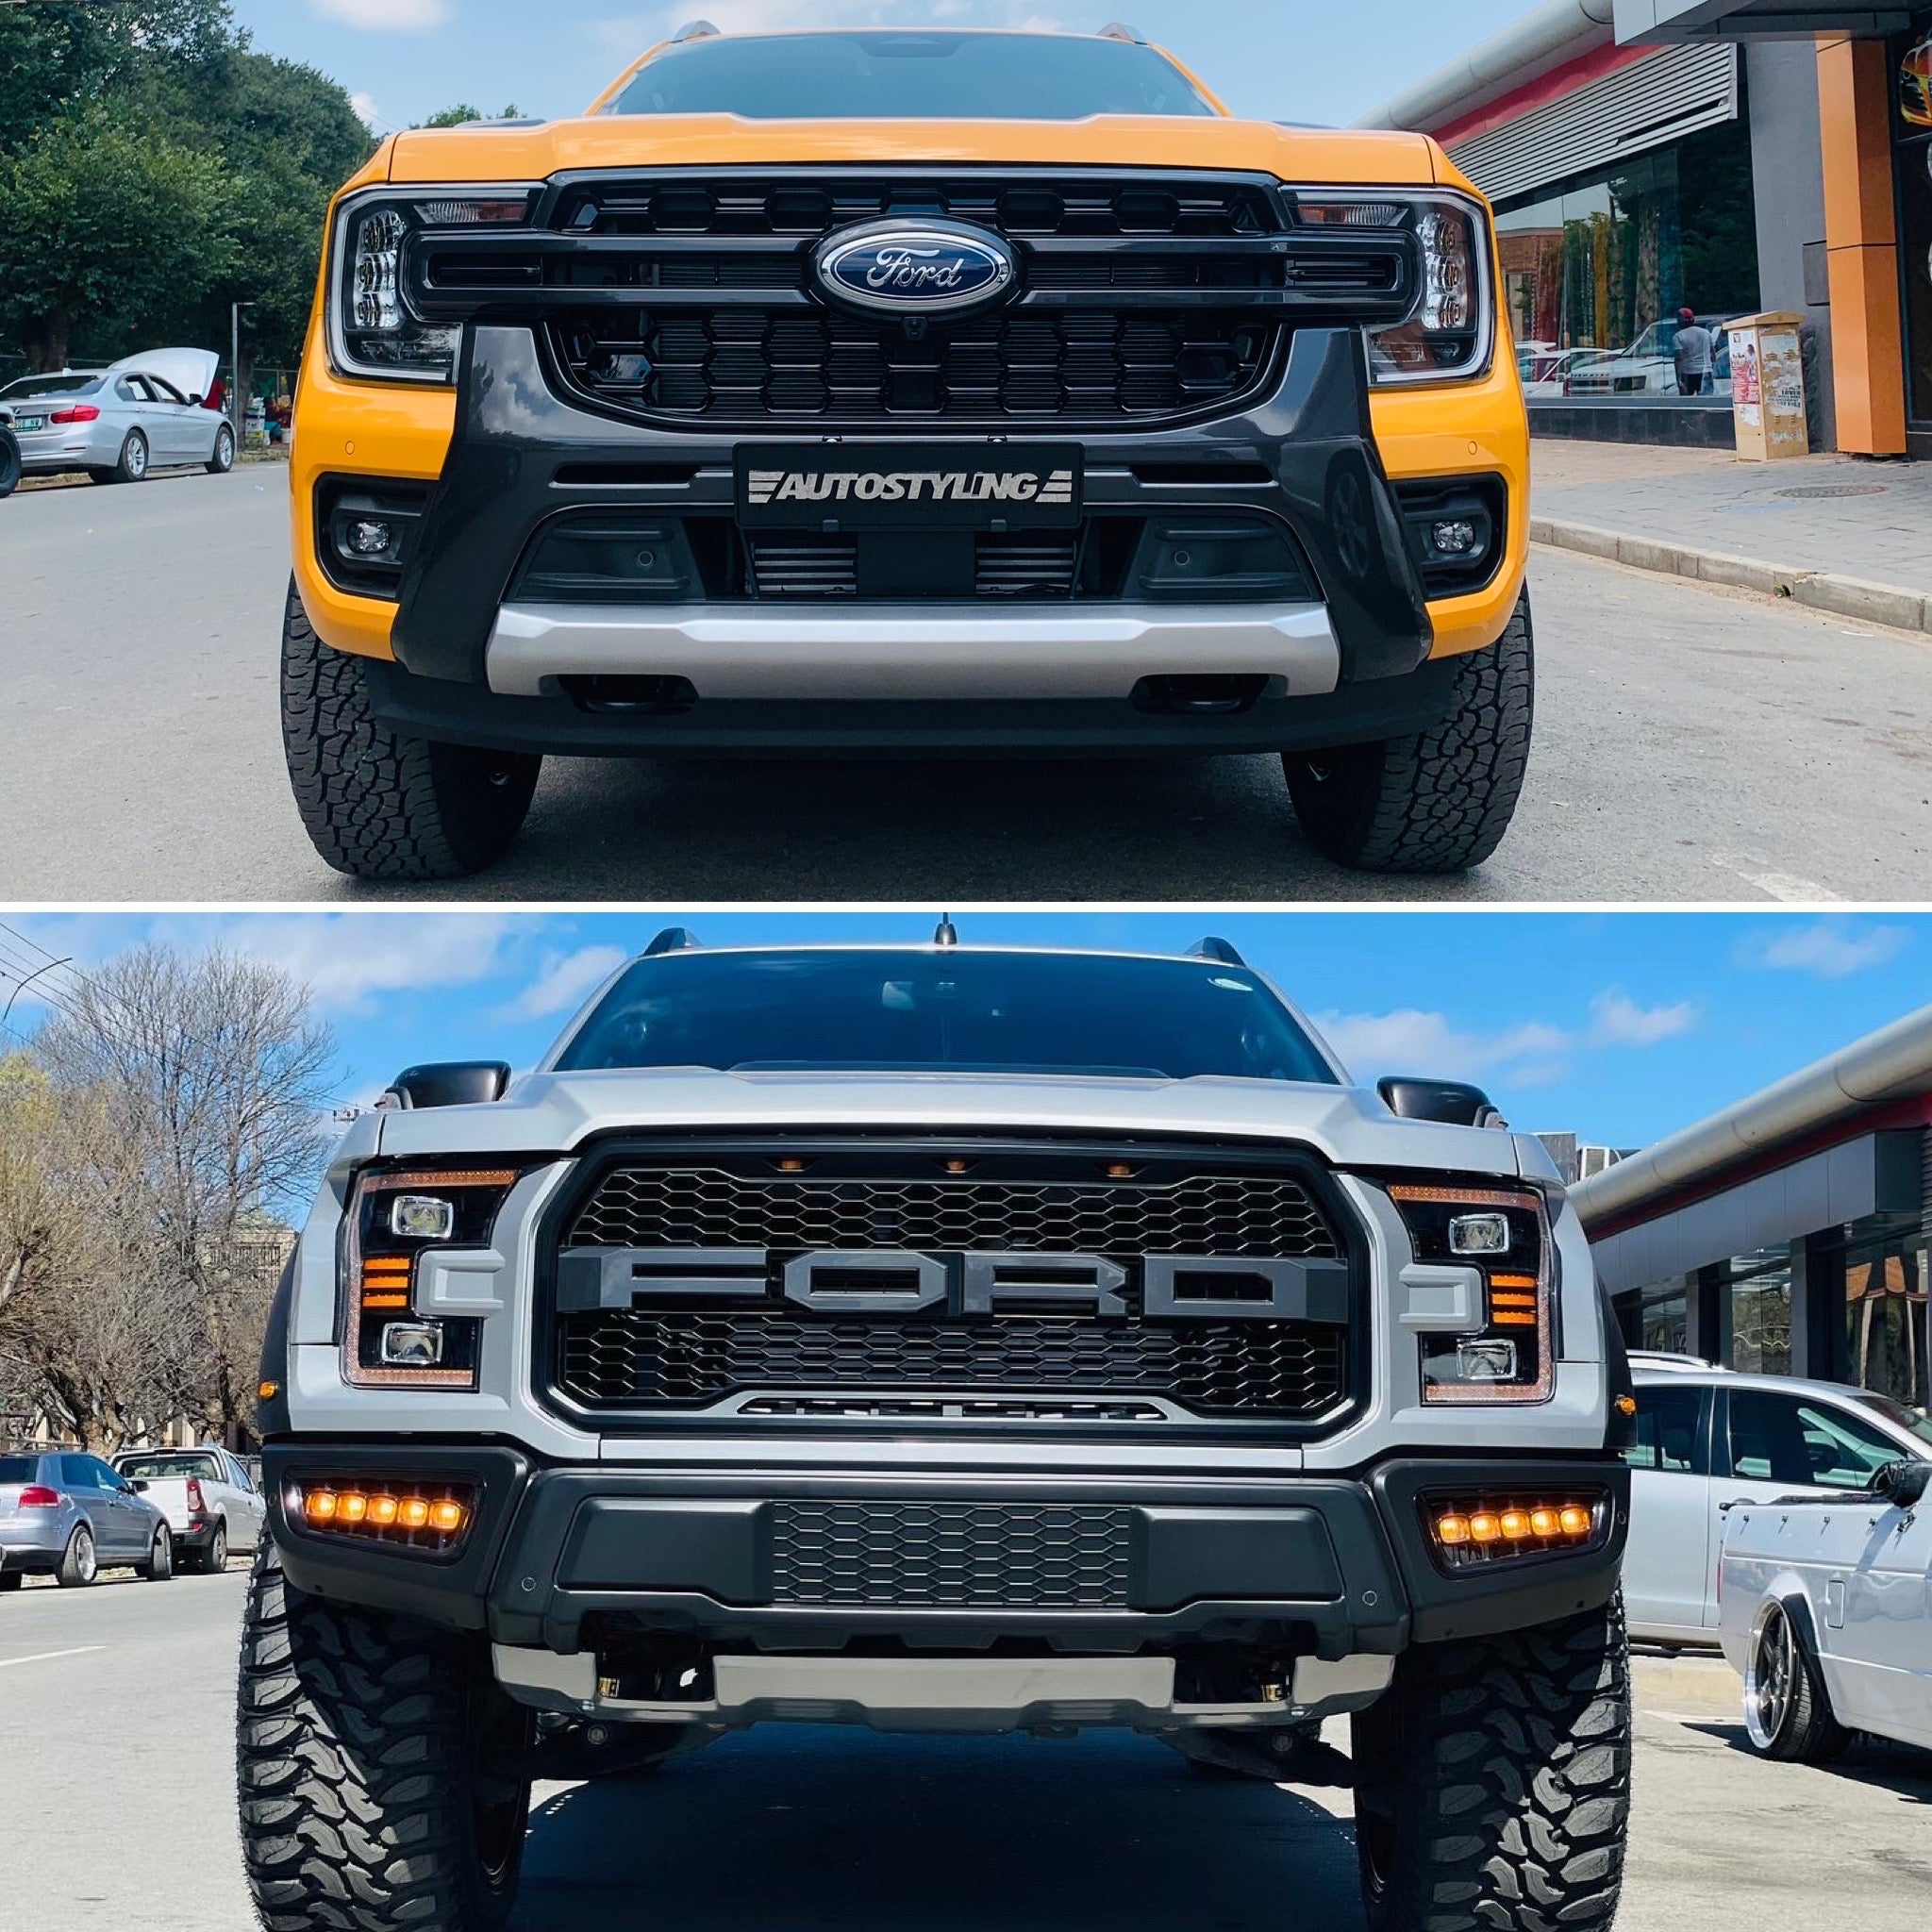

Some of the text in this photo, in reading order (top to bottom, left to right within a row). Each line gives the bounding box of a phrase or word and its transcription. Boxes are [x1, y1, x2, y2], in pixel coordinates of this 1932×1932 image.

[866, 246, 964, 288] Ford
[775, 471, 1039, 501] AUTOSTYLING
[558, 1245, 1349, 1318] FORD
